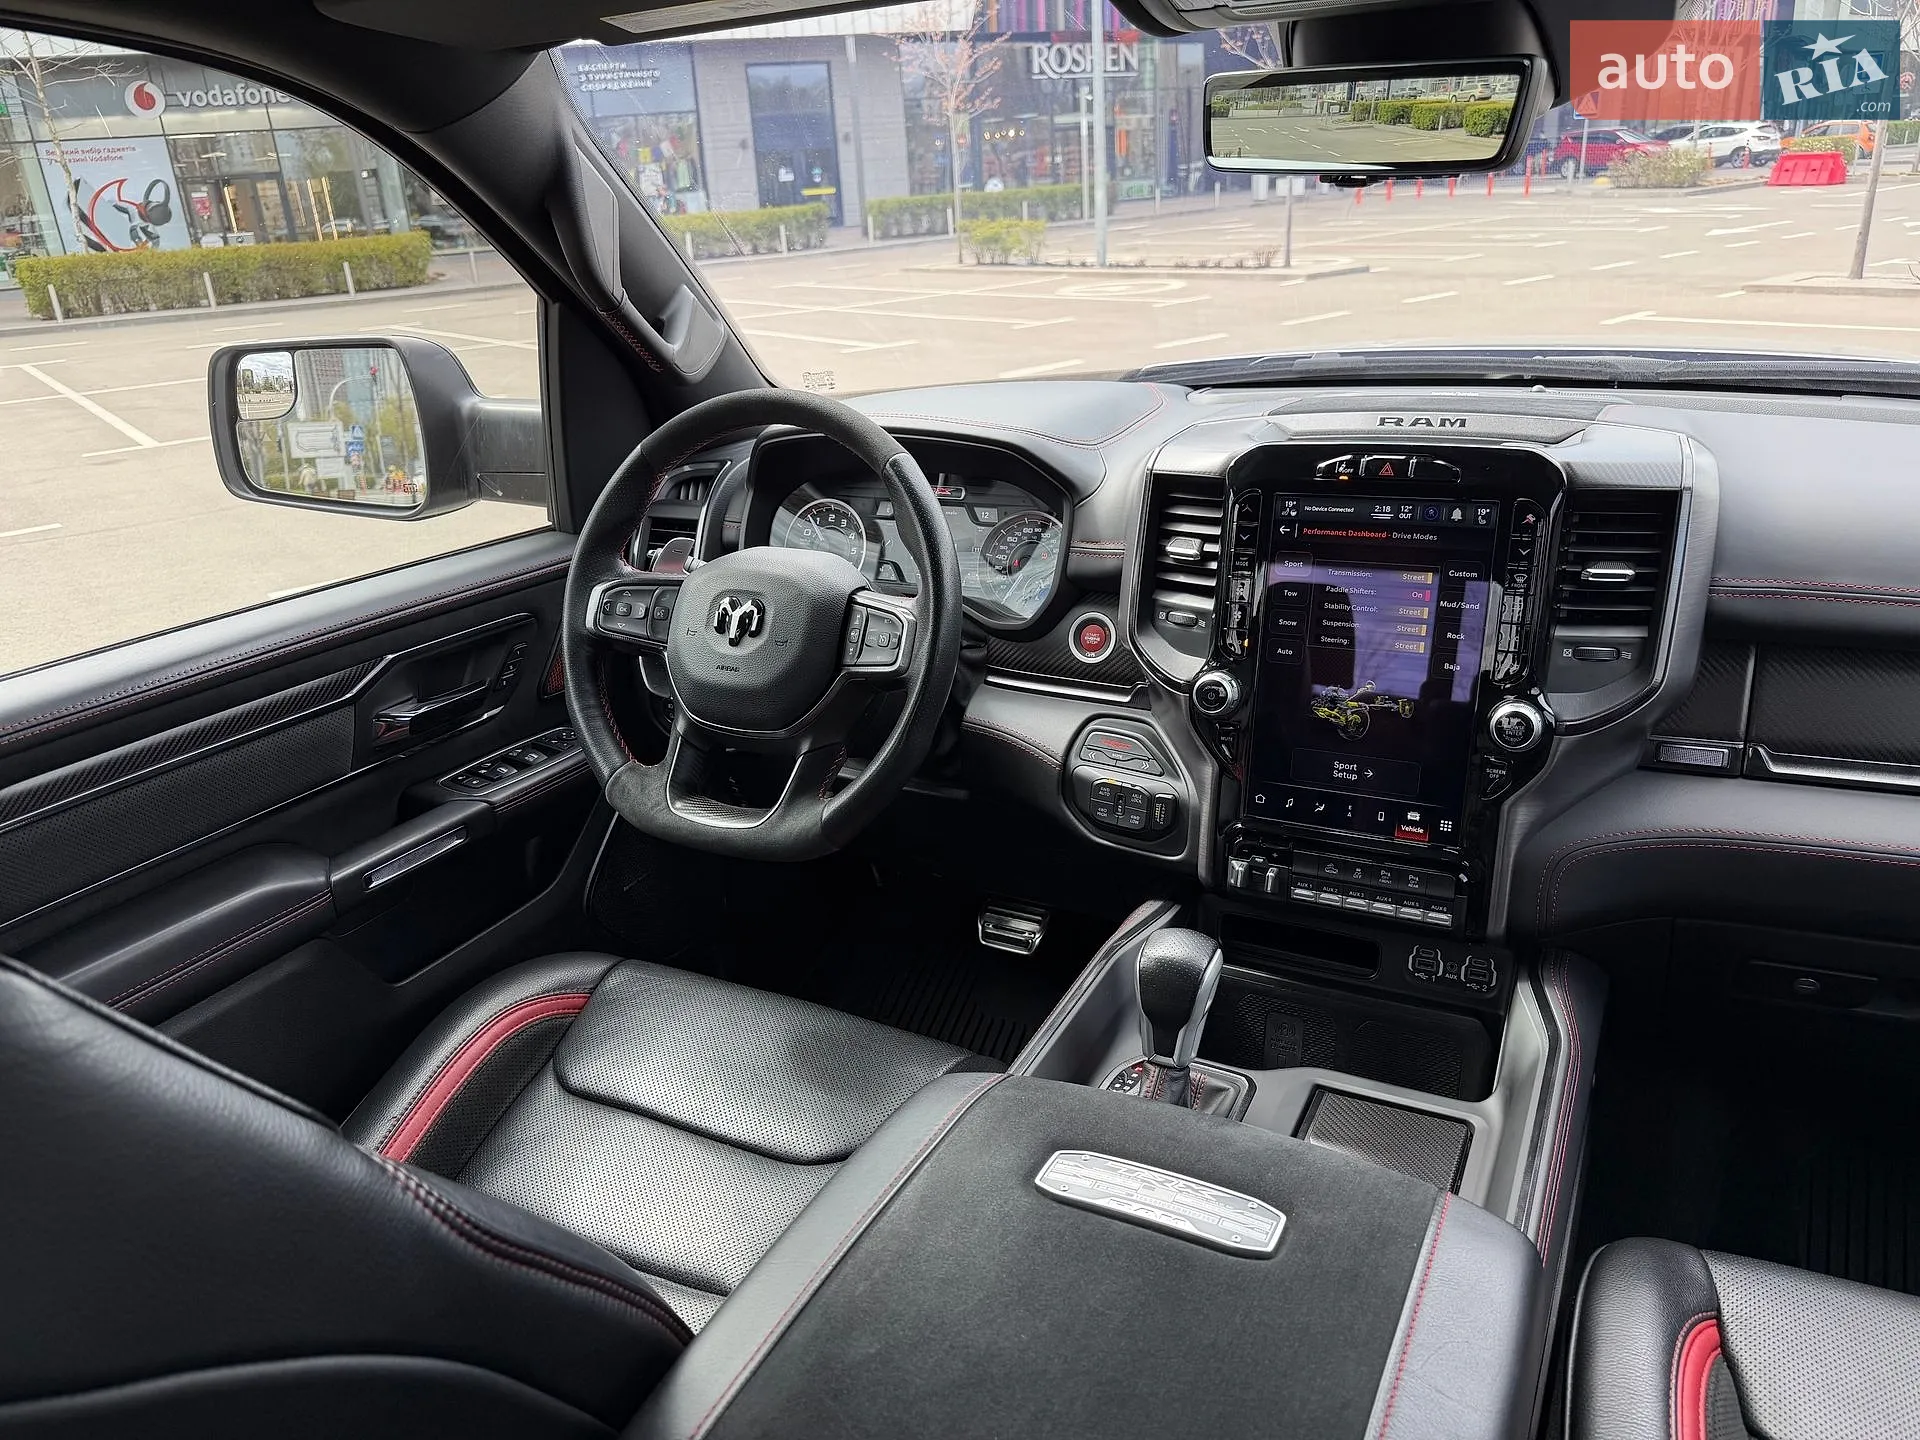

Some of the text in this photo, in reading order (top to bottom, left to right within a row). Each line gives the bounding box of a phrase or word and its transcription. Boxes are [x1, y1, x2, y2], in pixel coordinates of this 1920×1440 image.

[1377, 416, 1467, 428] RAM
[1374, 505, 1391, 513] 2:18
[828, 514, 836, 522] 2
[840, 519, 847, 527] 3
[848, 532, 855, 540] 4
[1303, 527, 1347, 537] Performance
[1348, 529, 1387, 538] Dashboard
[1392, 531, 1412, 540] Drive
[1413, 532, 1438, 541] Modes
[851, 547, 857, 555] 5
[1284, 560, 1303, 568] Sport
[1328, 568, 1373, 578] Transmission:
[1402, 573, 1425, 581] Street
[1448, 569, 1478, 578] Custom
[1284, 589, 1298, 597] Tow
[1325, 585, 1377, 596] Paddle Shifters:
[1412, 591, 1423, 599] On
[1324, 602, 1378, 613] Stability Control:
[1440, 600, 1480, 610] Mud/Sand
[1398, 608, 1421, 616] Street
[1278, 618, 1298, 627] Snow
[1322, 619, 1361, 629] Suspension:
[1396, 625, 1419, 633] Street
[1320, 635, 1350, 645] Steering:
[1446, 632, 1465, 640] Rock
[1394, 642, 1417, 650] Street
[1443, 662, 1461, 671] Baja
[1333, 761, 1357, 771] Sport
[1333, 770, 1358, 780] Setup
[1486, 767, 1506, 775] SCREEN
[1401, 824, 1424, 834] Vehicle
[1481, 984, 1488, 992] 2
